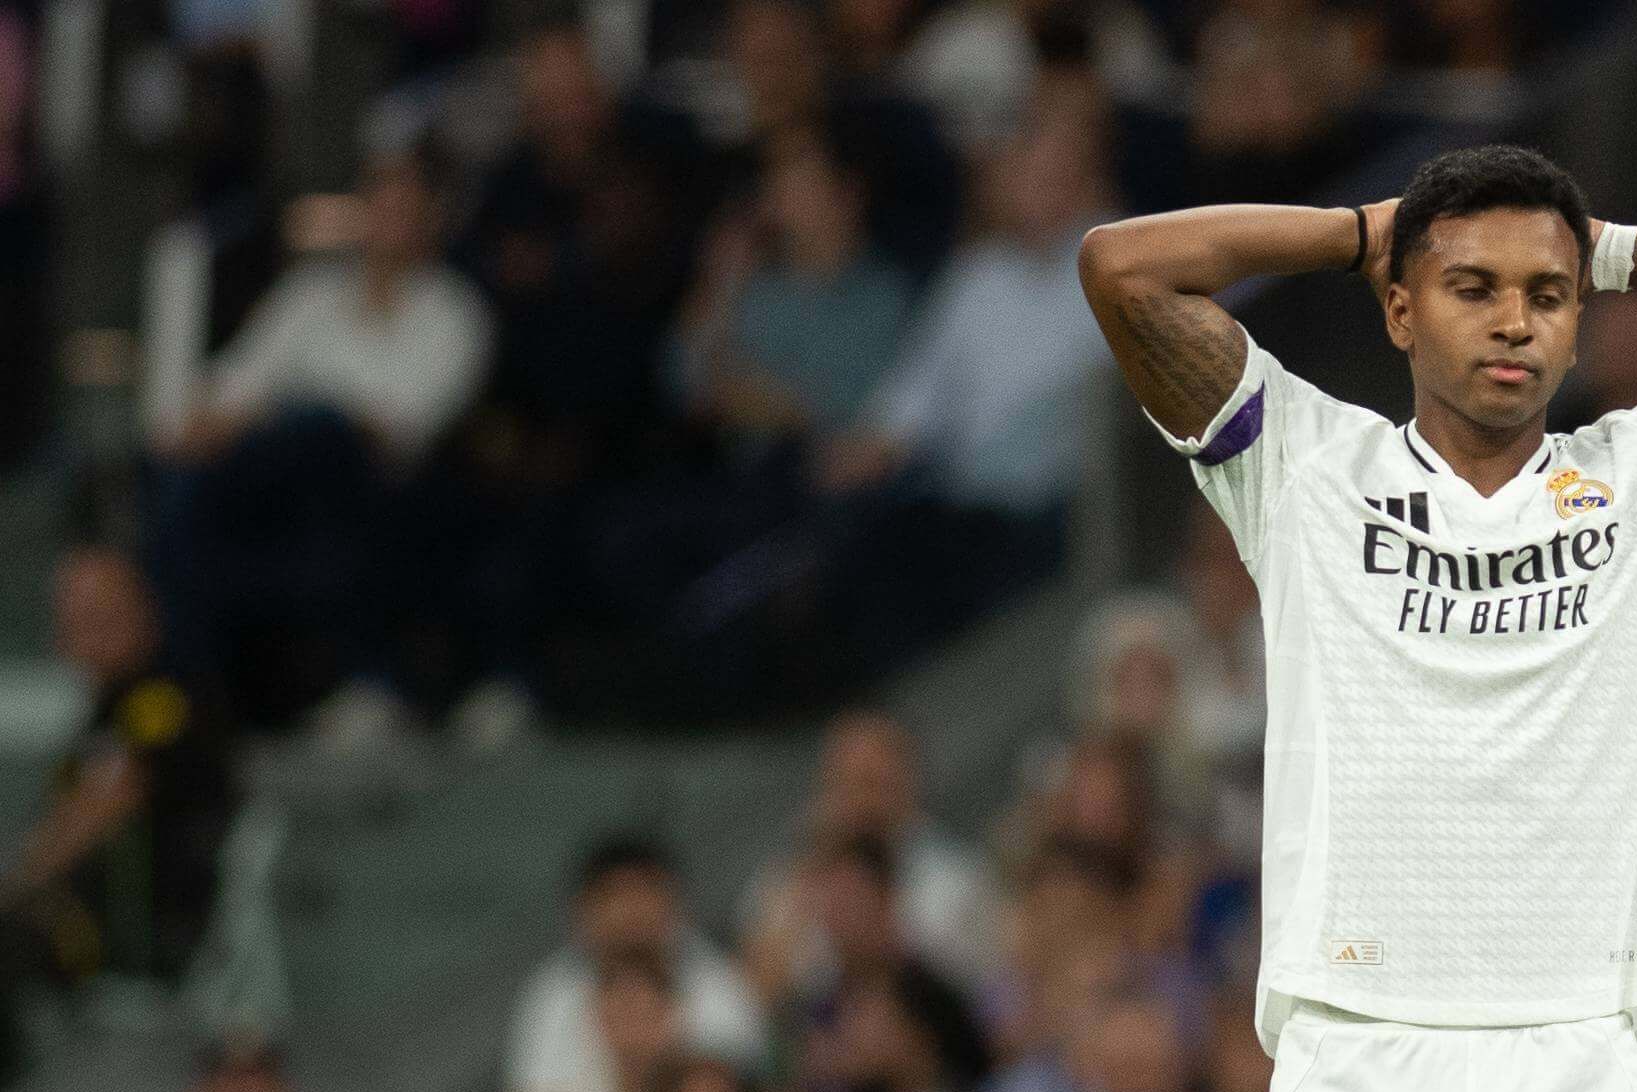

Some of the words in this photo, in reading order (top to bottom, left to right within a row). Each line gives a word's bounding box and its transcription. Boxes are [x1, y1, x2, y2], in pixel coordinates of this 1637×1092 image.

[1362, 521, 1620, 592] Emirates
[1397, 587, 1457, 635] FLY
[1468, 583, 1590, 635] BETTER
